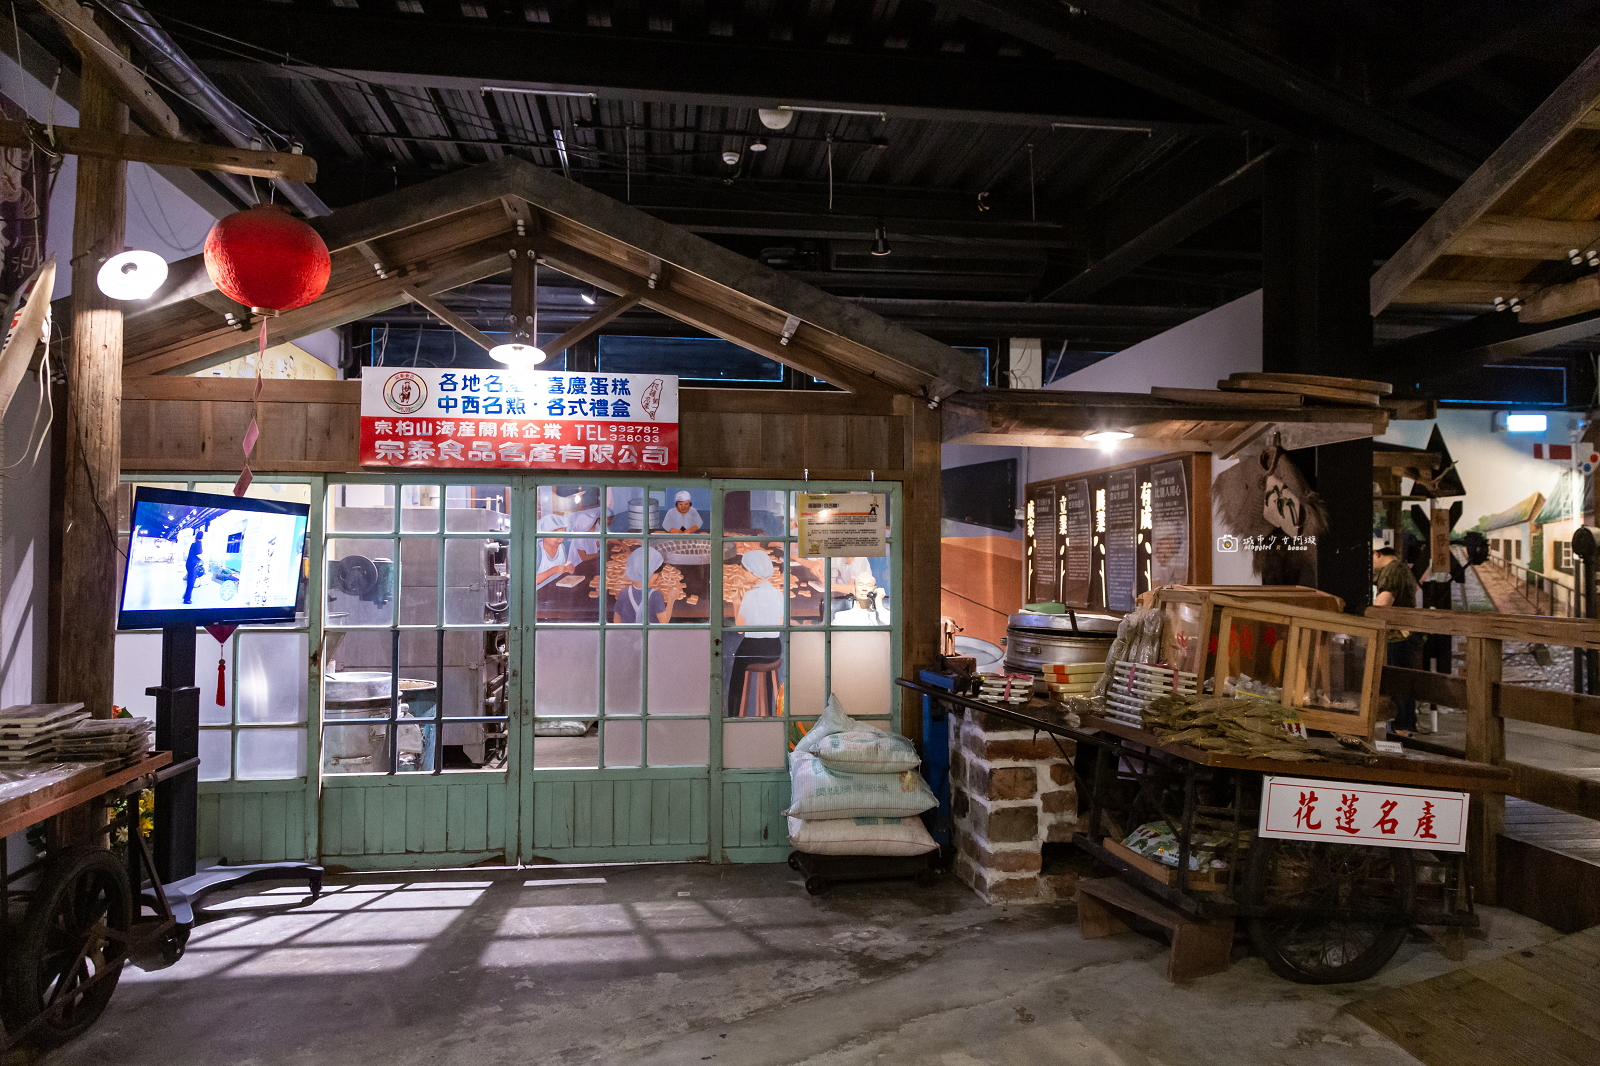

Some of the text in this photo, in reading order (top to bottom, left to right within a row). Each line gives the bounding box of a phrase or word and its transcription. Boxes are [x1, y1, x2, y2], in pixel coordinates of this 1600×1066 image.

[574, 424, 607, 441] TEL
[609, 426, 660, 434] 332782
[609, 434, 660, 442] 328033
[374, 439, 669, 466] 宗泰食品名產有限公司
[1293, 790, 1438, 840] 花蓮名產
